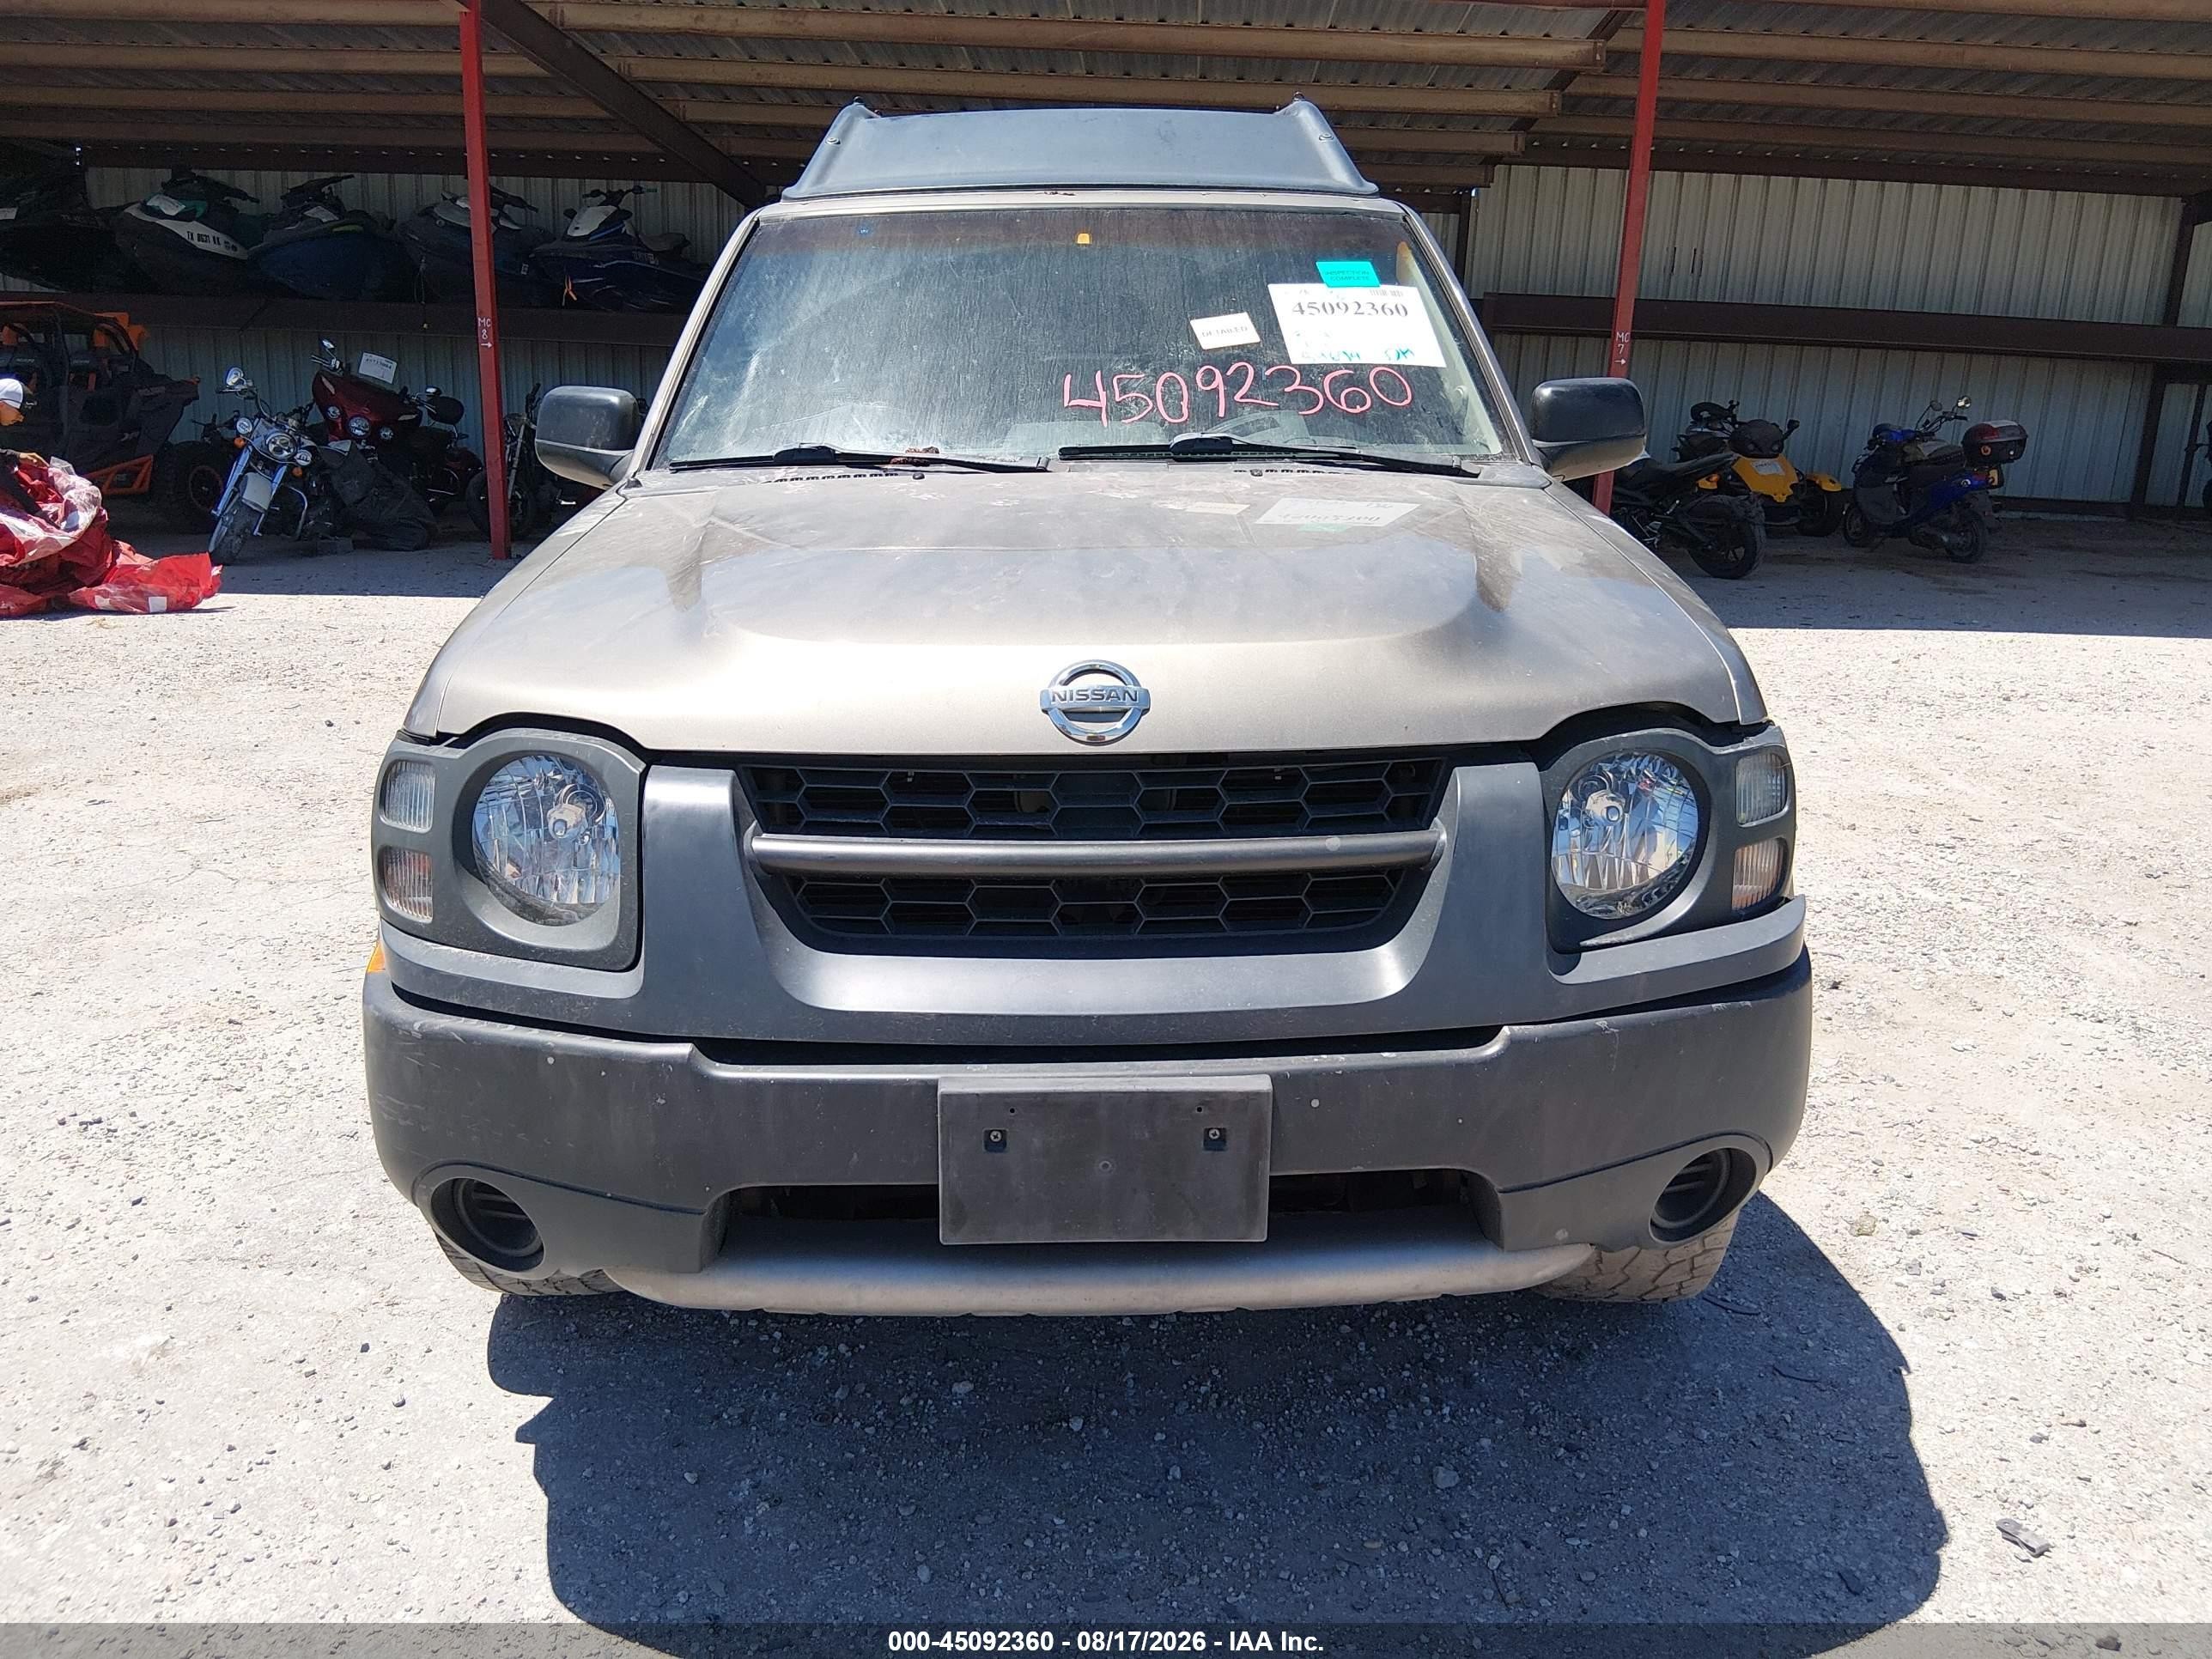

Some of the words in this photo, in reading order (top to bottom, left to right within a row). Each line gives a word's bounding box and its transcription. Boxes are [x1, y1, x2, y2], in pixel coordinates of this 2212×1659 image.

[1291, 301, 1408, 317] 45092360
[477, 317, 491, 327] MC
[482, 328, 489, 340] 8
[1615, 331, 1631, 343] MC
[1617, 343, 1625, 355] 7
[1063, 362, 1413, 427] 45092360
[1052, 689, 1138, 702] NISSAN
